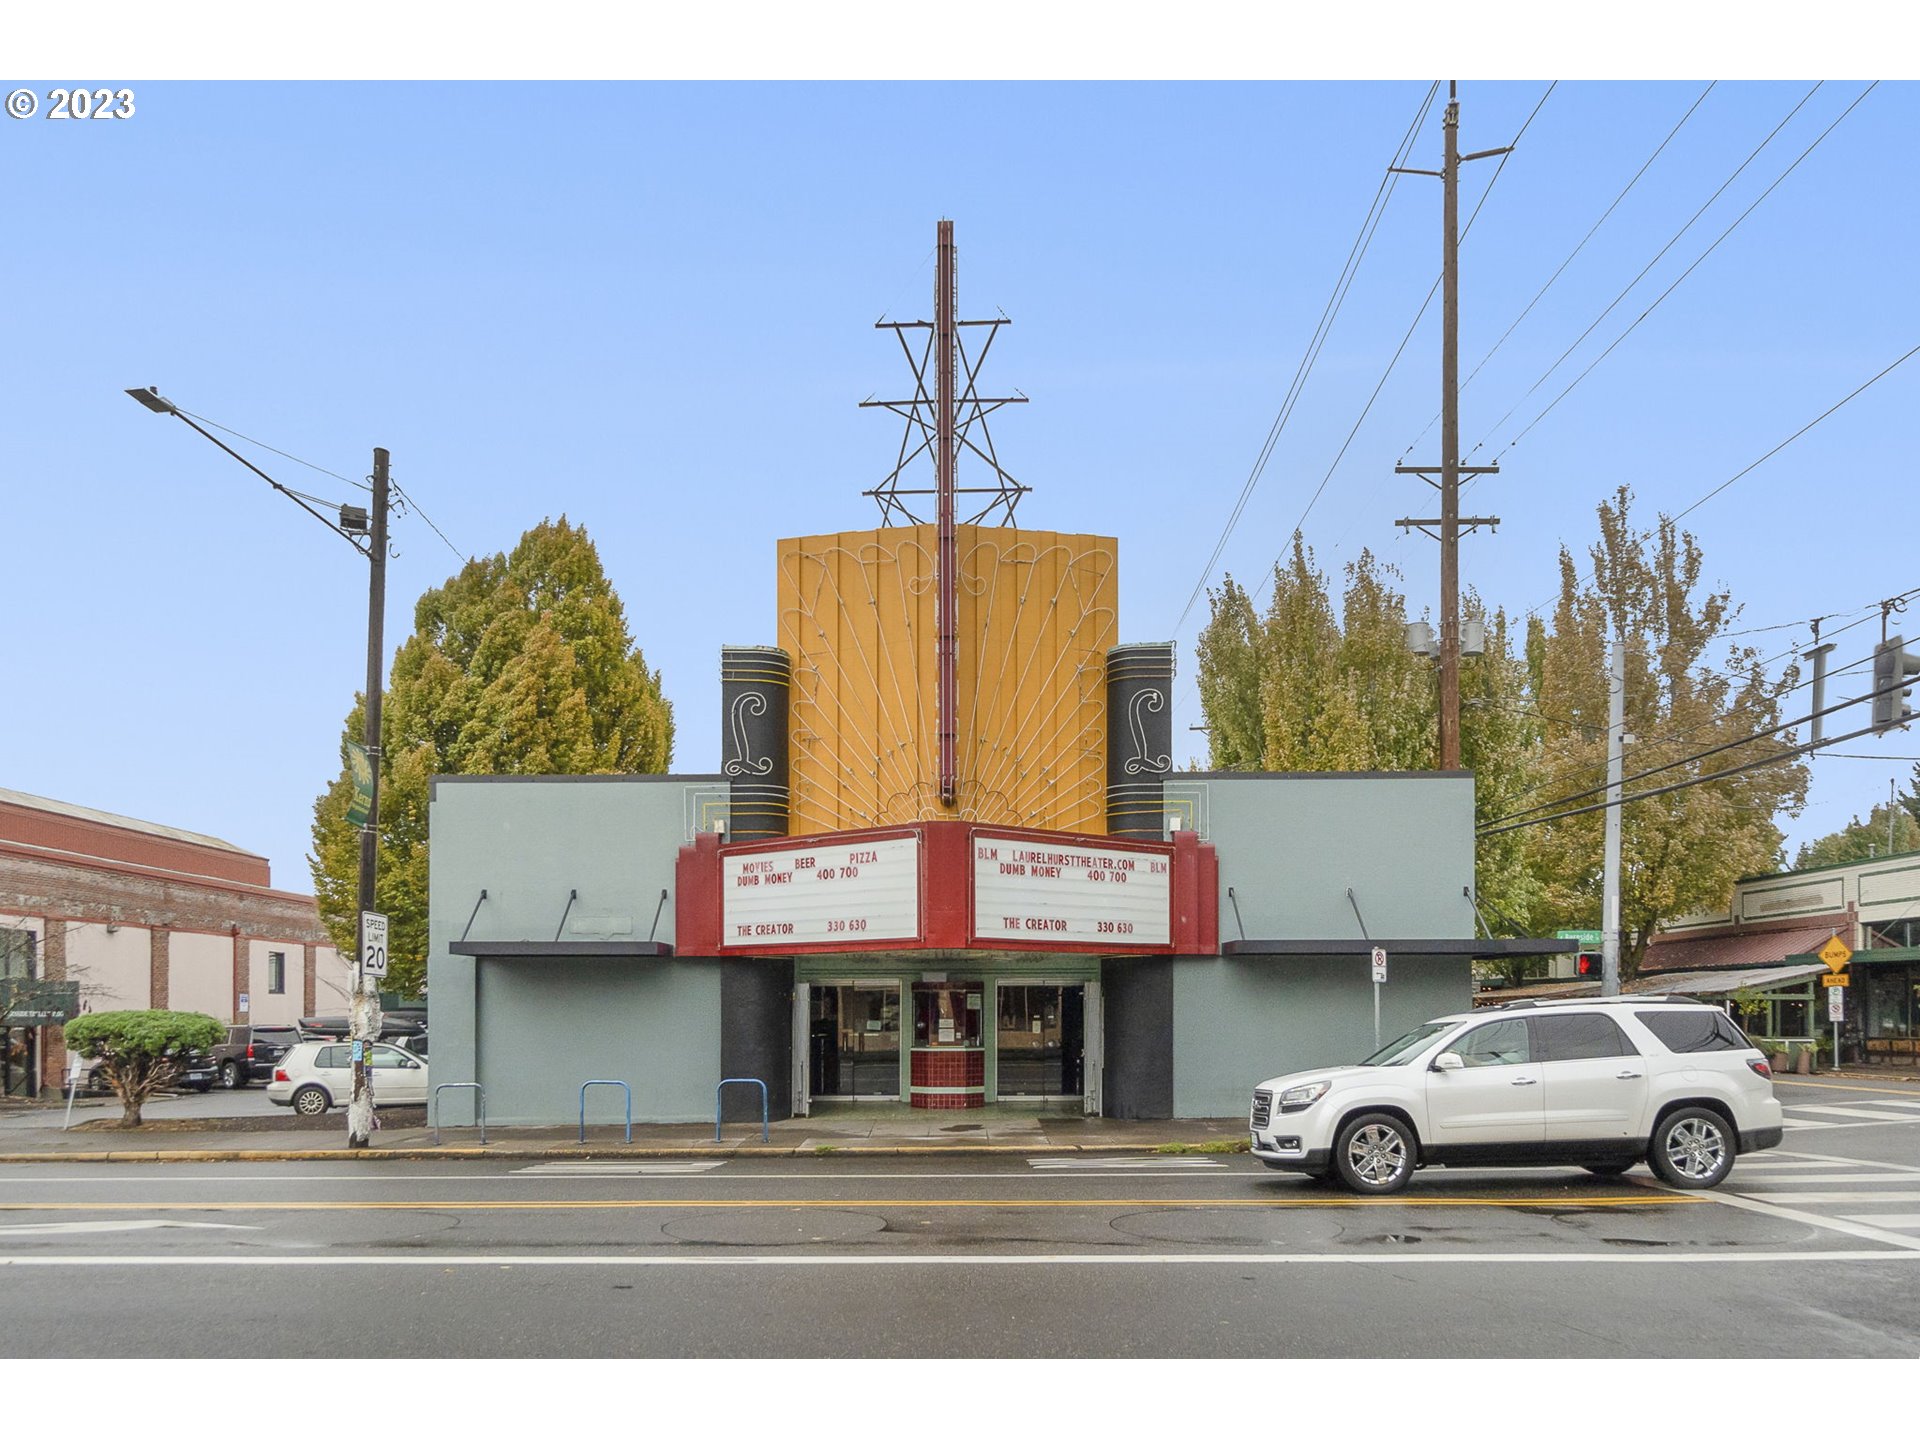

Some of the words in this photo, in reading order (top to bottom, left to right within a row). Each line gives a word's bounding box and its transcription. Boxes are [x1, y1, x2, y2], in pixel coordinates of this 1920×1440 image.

[742, 860, 774, 874] MOVIES
[795, 857, 816, 869] BEER
[850, 851, 878, 865] PIZZA
[977, 847, 998, 861] BLM
[1012, 850, 1135, 871] LAURELHURSTTHEATER.COM
[1150, 862, 1167, 874] BLM
[737, 875, 760, 887] DUMB
[764, 872, 793, 885] MONEY
[816, 868, 835, 880] 400
[839, 867, 859, 879] 700
[999, 863, 1026, 876] DUMB
[1031, 867, 1062, 879] MONEY
[1087, 870, 1106, 882] 400
[1109, 871, 1127, 883] 700
[366, 918, 385, 931] SPEED
[737, 925, 752, 937] THE
[755, 923, 794, 936] CREATOR
[827, 920, 846, 932] 330
[849, 919, 867, 932] 630
[1003, 917, 1021, 930] THE
[1025, 918, 1068, 932] CREATOR
[1097, 921, 1115, 934] 330
[1117, 922, 1134, 934] 630
[368, 932, 384, 943] LIMIT
[366, 945, 385, 969] 20
[1824, 950, 1847, 959] BUMPS
